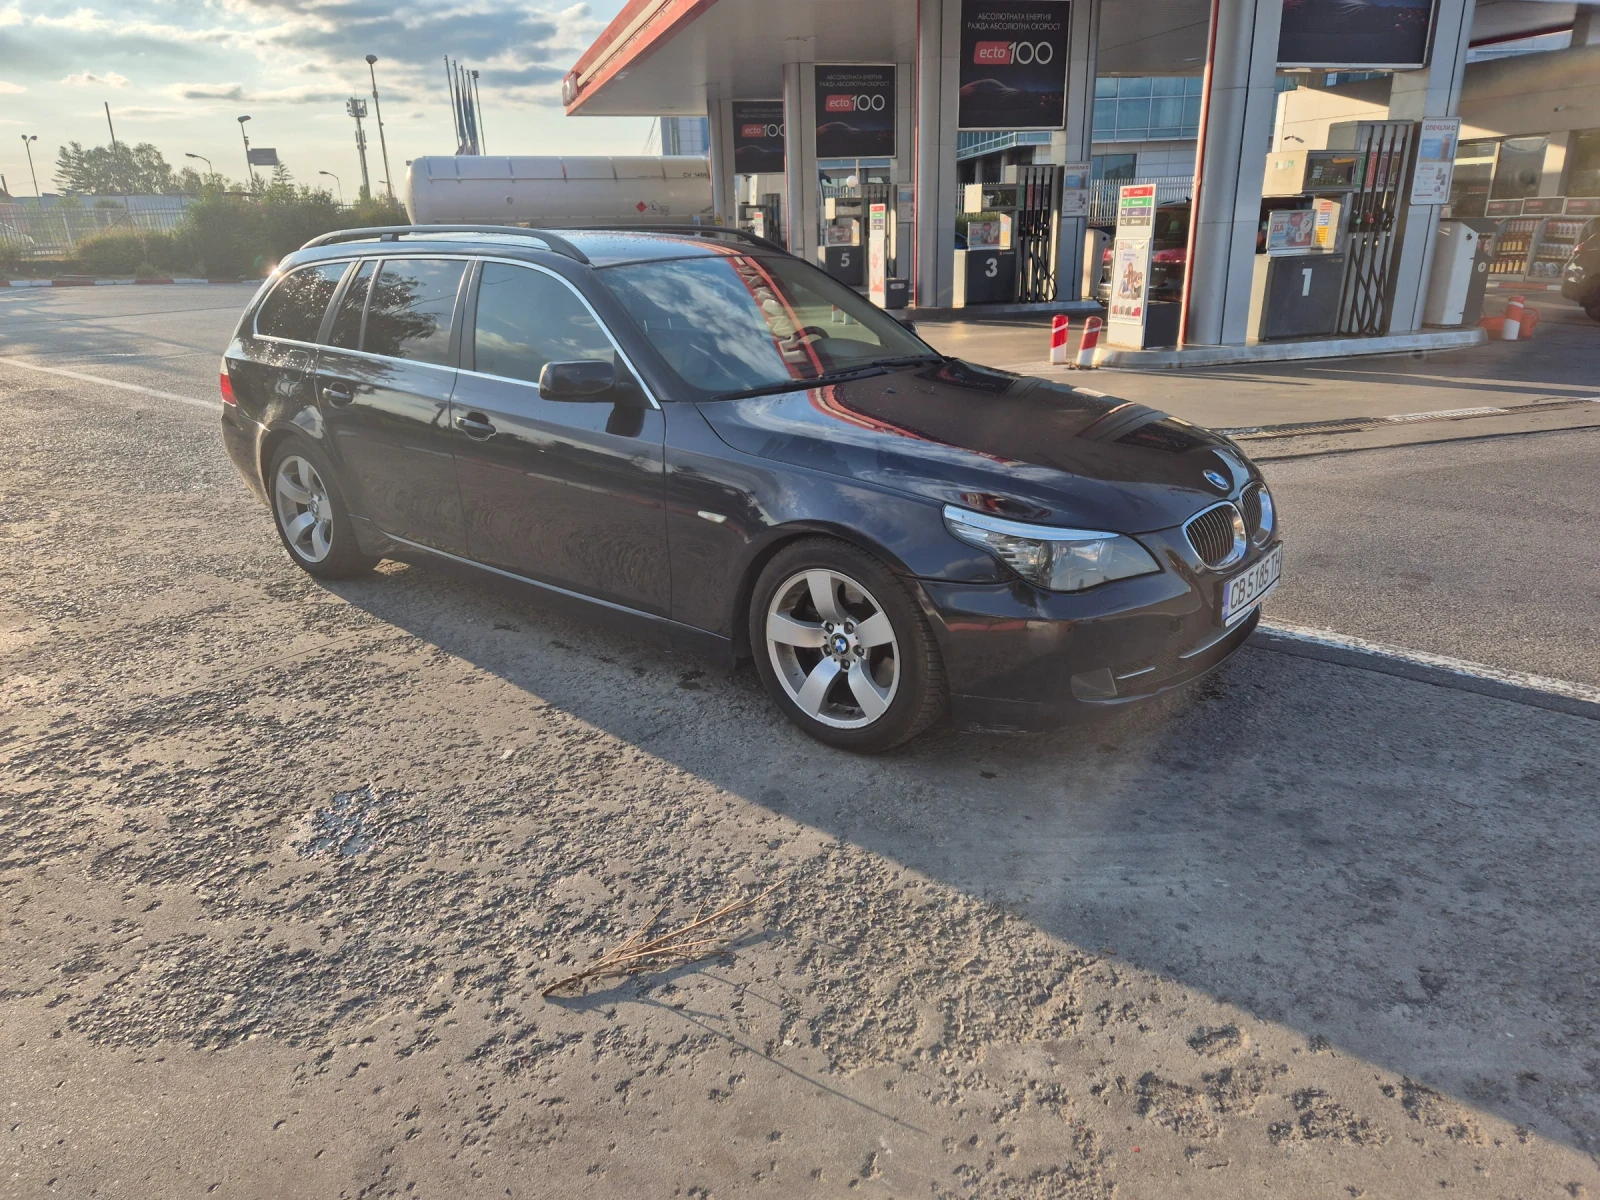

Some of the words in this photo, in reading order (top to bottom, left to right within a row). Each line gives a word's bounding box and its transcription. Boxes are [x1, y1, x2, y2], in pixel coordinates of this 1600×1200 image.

[967, 22, 989, 30] РАЖДА
[990, 22, 1030, 30] АБСОЛЮТНА
[1030, 22, 1060, 30] СКОРОСТ
[840, 253, 850, 267] 5
[985, 257, 998, 278] 3
[1302, 268, 1313, 297] 1
[1231, 577, 1246, 609] CB
[1247, 559, 1269, 598] 5185
